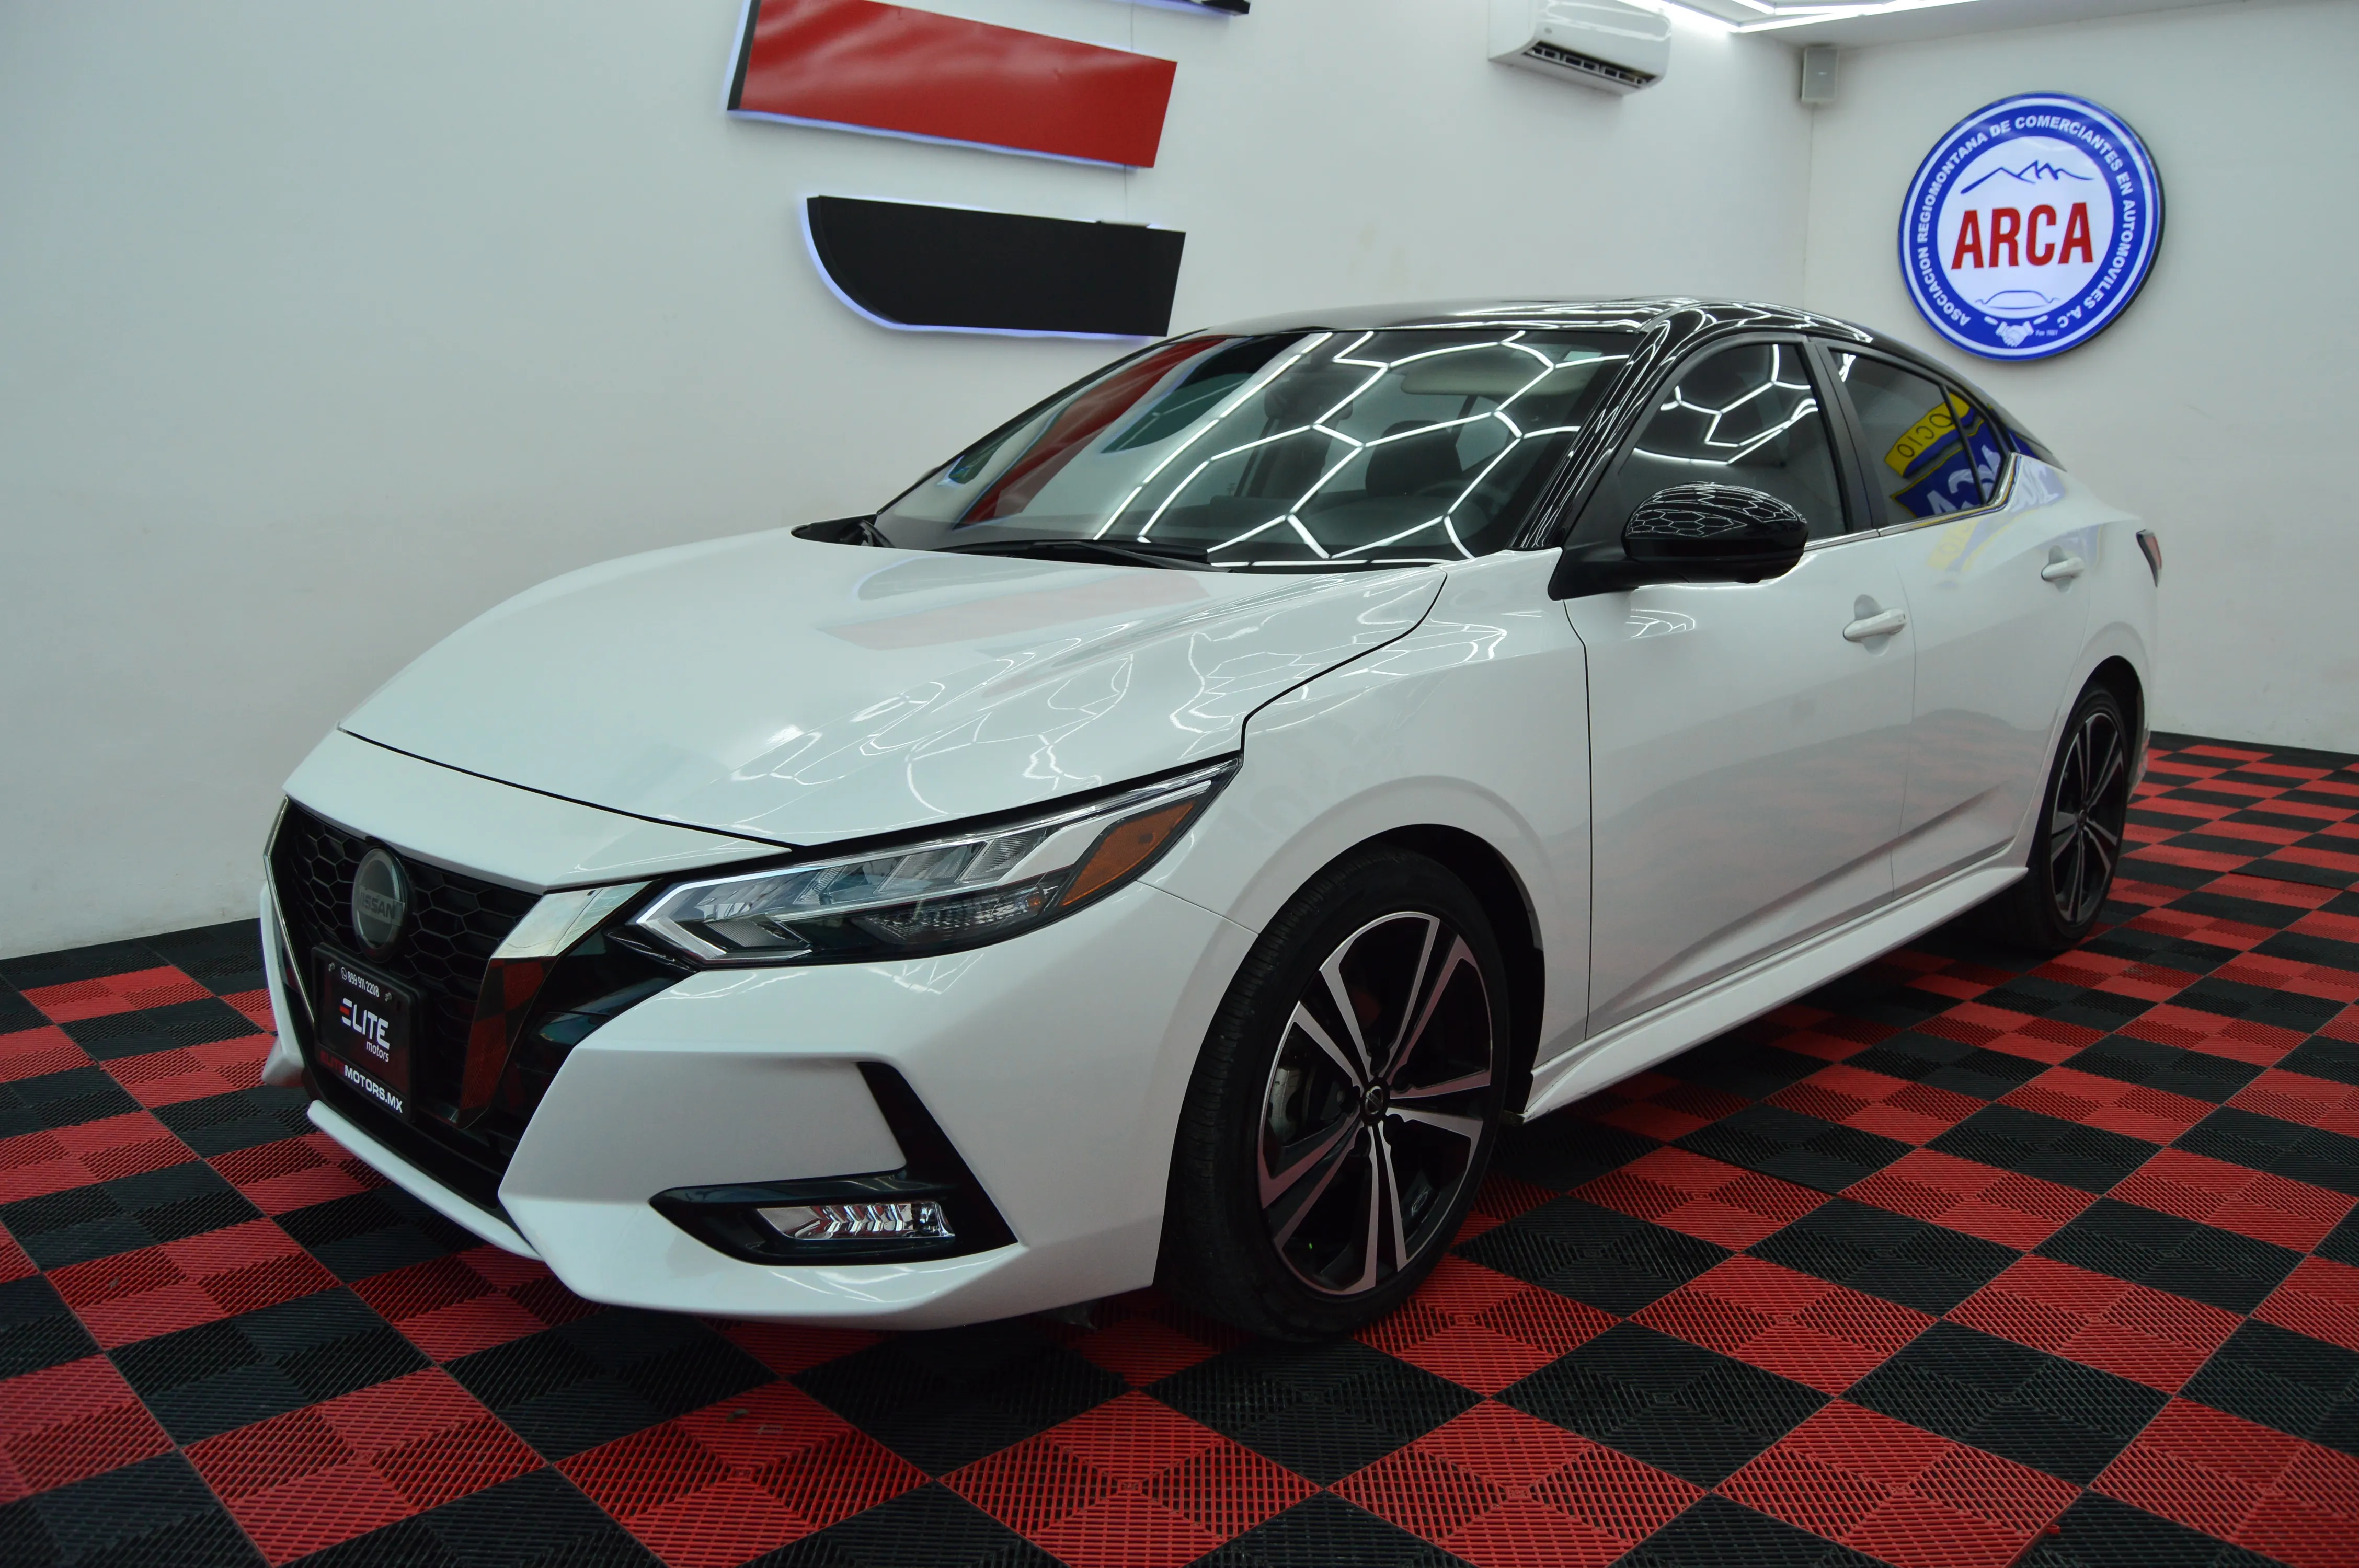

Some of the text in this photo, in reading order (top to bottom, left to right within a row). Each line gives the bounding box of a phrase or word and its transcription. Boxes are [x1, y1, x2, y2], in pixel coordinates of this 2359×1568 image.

[1988, 119, 2011, 138] DE
[2014, 115, 2123, 172] COMERCIANTES
[1917, 132, 1988, 244] REGIOMONTANA
[2115, 171, 2134, 196] EN
[1951, 201, 2094, 270] ARCA
[2083, 200, 2136, 309] AUTOMOVILES
[1917, 246, 1971, 327] ASOCIACION
[347, 971, 380, 997] 899 911 2208
[339, 997, 390, 1050] ELITE
[366, 1041, 390, 1063] motors
